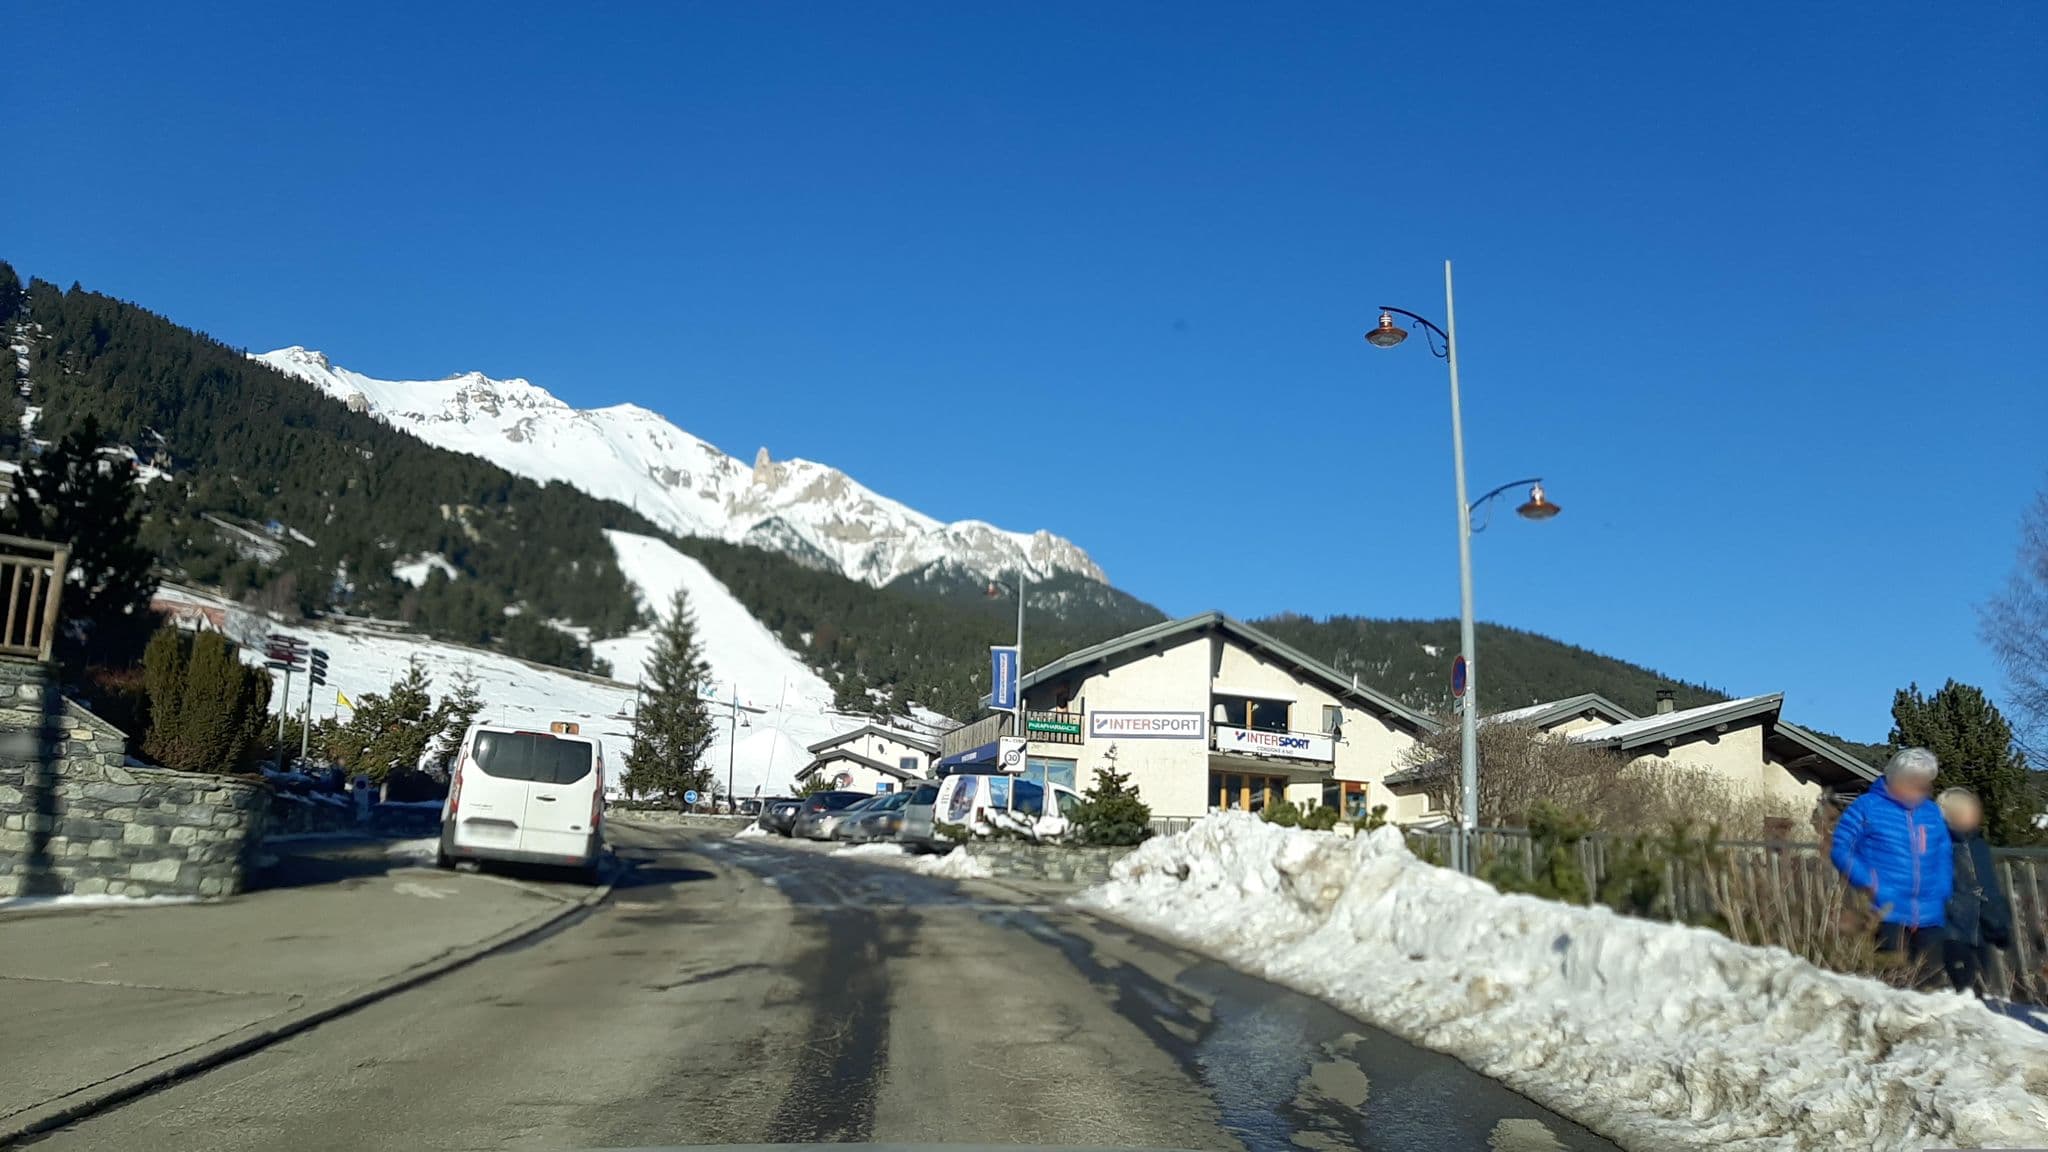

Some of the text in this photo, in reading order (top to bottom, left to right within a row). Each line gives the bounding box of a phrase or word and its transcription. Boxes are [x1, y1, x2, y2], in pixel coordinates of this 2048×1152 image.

[1109, 718, 1199, 731] INTERSPORT
[1247, 732, 1311, 750] INTERSPORT
[1008, 754, 1018, 762] 30
